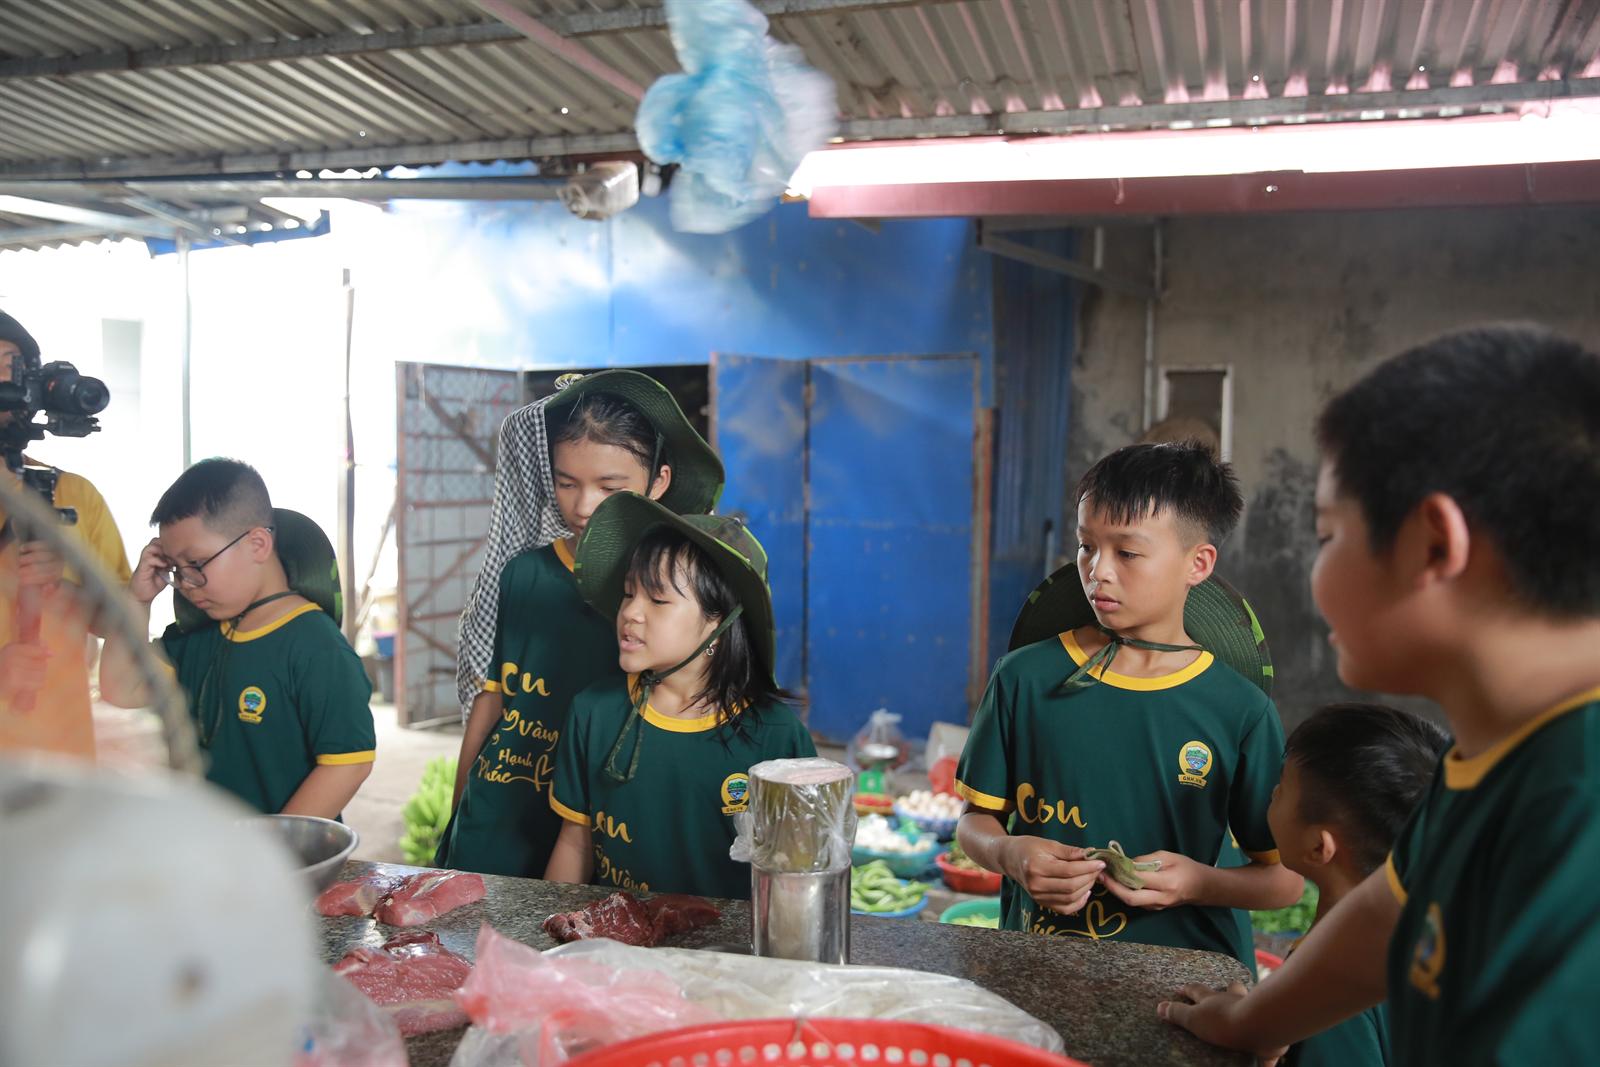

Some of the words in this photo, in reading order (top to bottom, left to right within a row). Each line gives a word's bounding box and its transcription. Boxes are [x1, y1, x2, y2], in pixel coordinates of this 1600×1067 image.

[501, 662, 551, 696] Cn
[498, 748, 534, 768] Hạnh
[1016, 782, 1088, 829] Con
